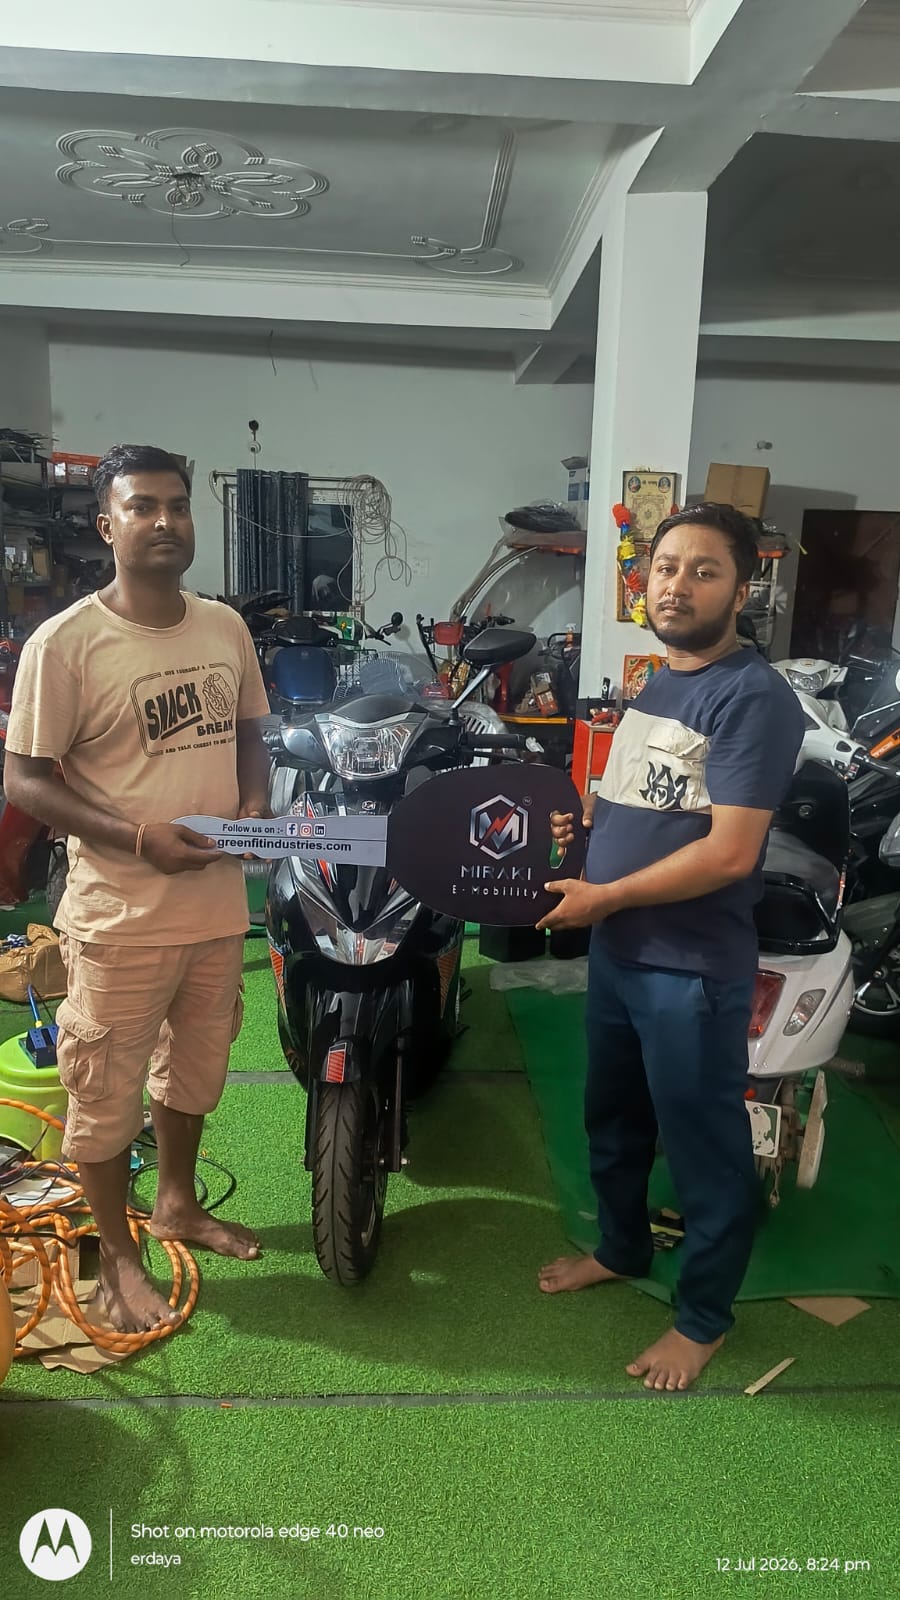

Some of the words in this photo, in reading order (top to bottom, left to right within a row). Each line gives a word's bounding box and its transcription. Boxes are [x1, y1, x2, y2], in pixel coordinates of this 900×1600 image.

[145, 682, 202, 741] SNACK
[196, 719, 233, 737] BREAK
[222, 823, 250, 833] Follow
[252, 826, 262, 834] us
[264, 826, 275, 834] on
[217, 838, 351, 852] greenfitindustries.com
[461, 865, 531, 880] MIRAKI
